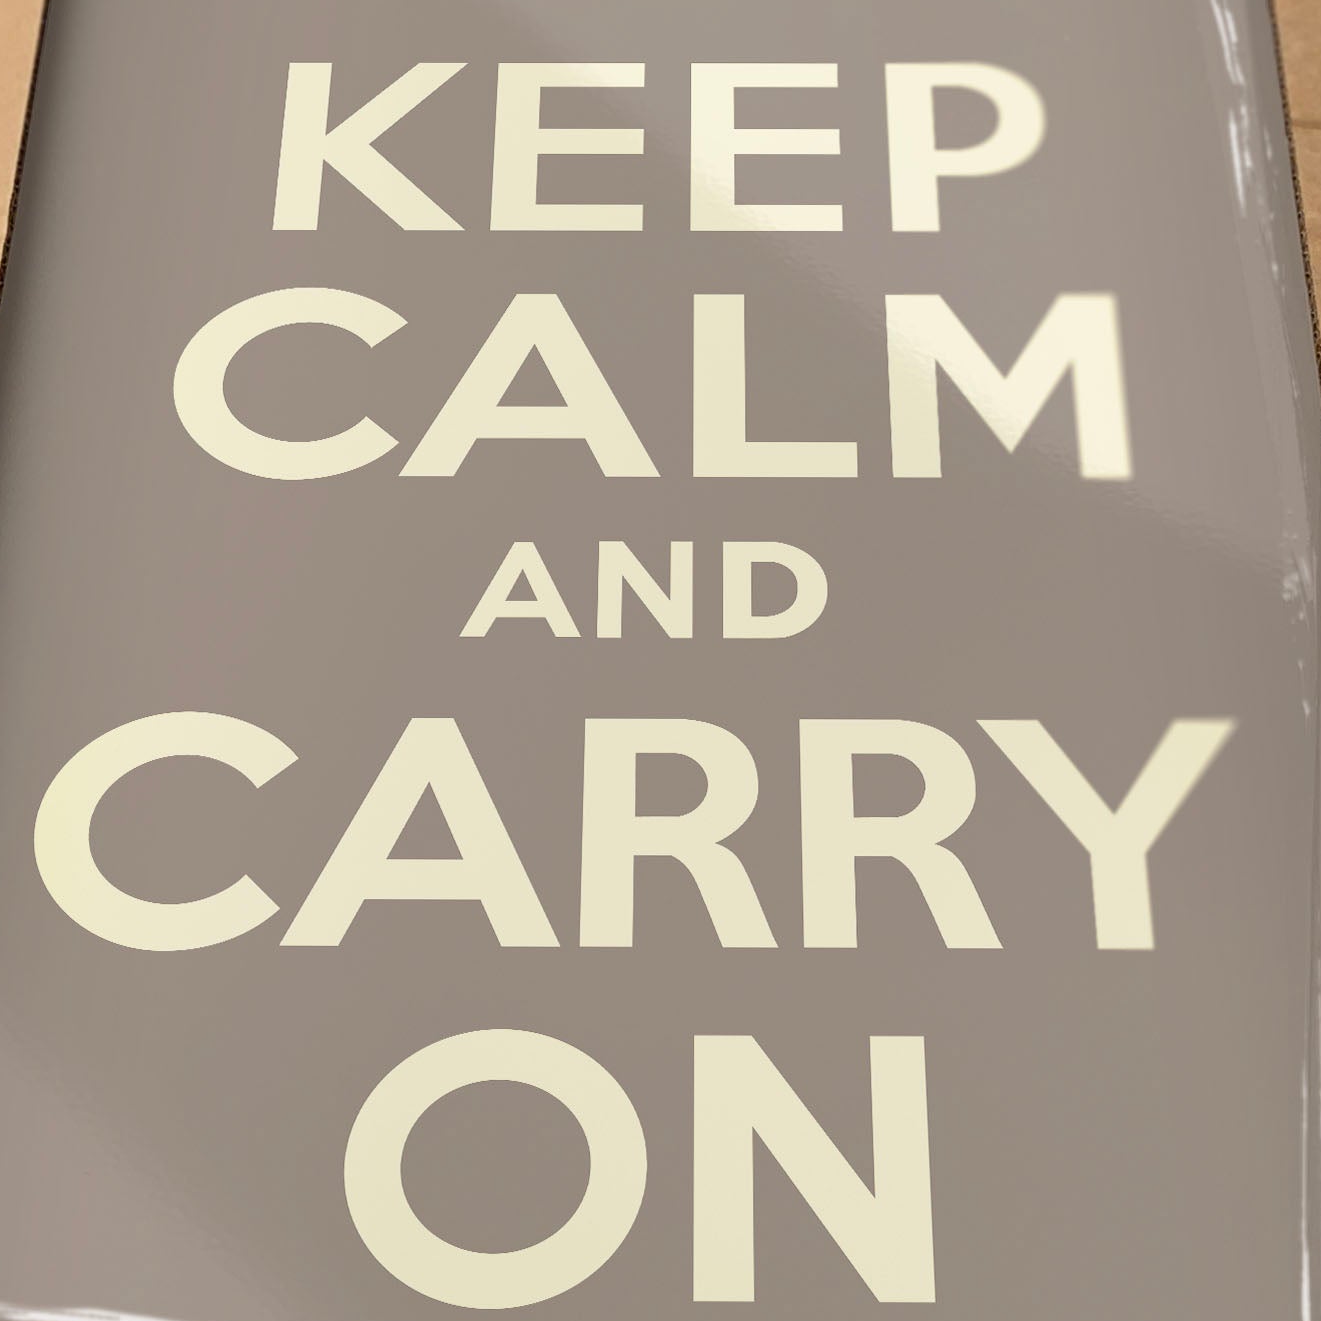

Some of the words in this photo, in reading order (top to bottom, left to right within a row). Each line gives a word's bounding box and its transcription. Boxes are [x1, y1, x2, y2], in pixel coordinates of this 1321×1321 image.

[270, 61, 1047, 233] KEEP
[172, 287, 1135, 481] CALM
[459, 540, 828, 639] AND
[33, 710, 1235, 952] CARRY
[343, 1028, 937, 1310] ON
